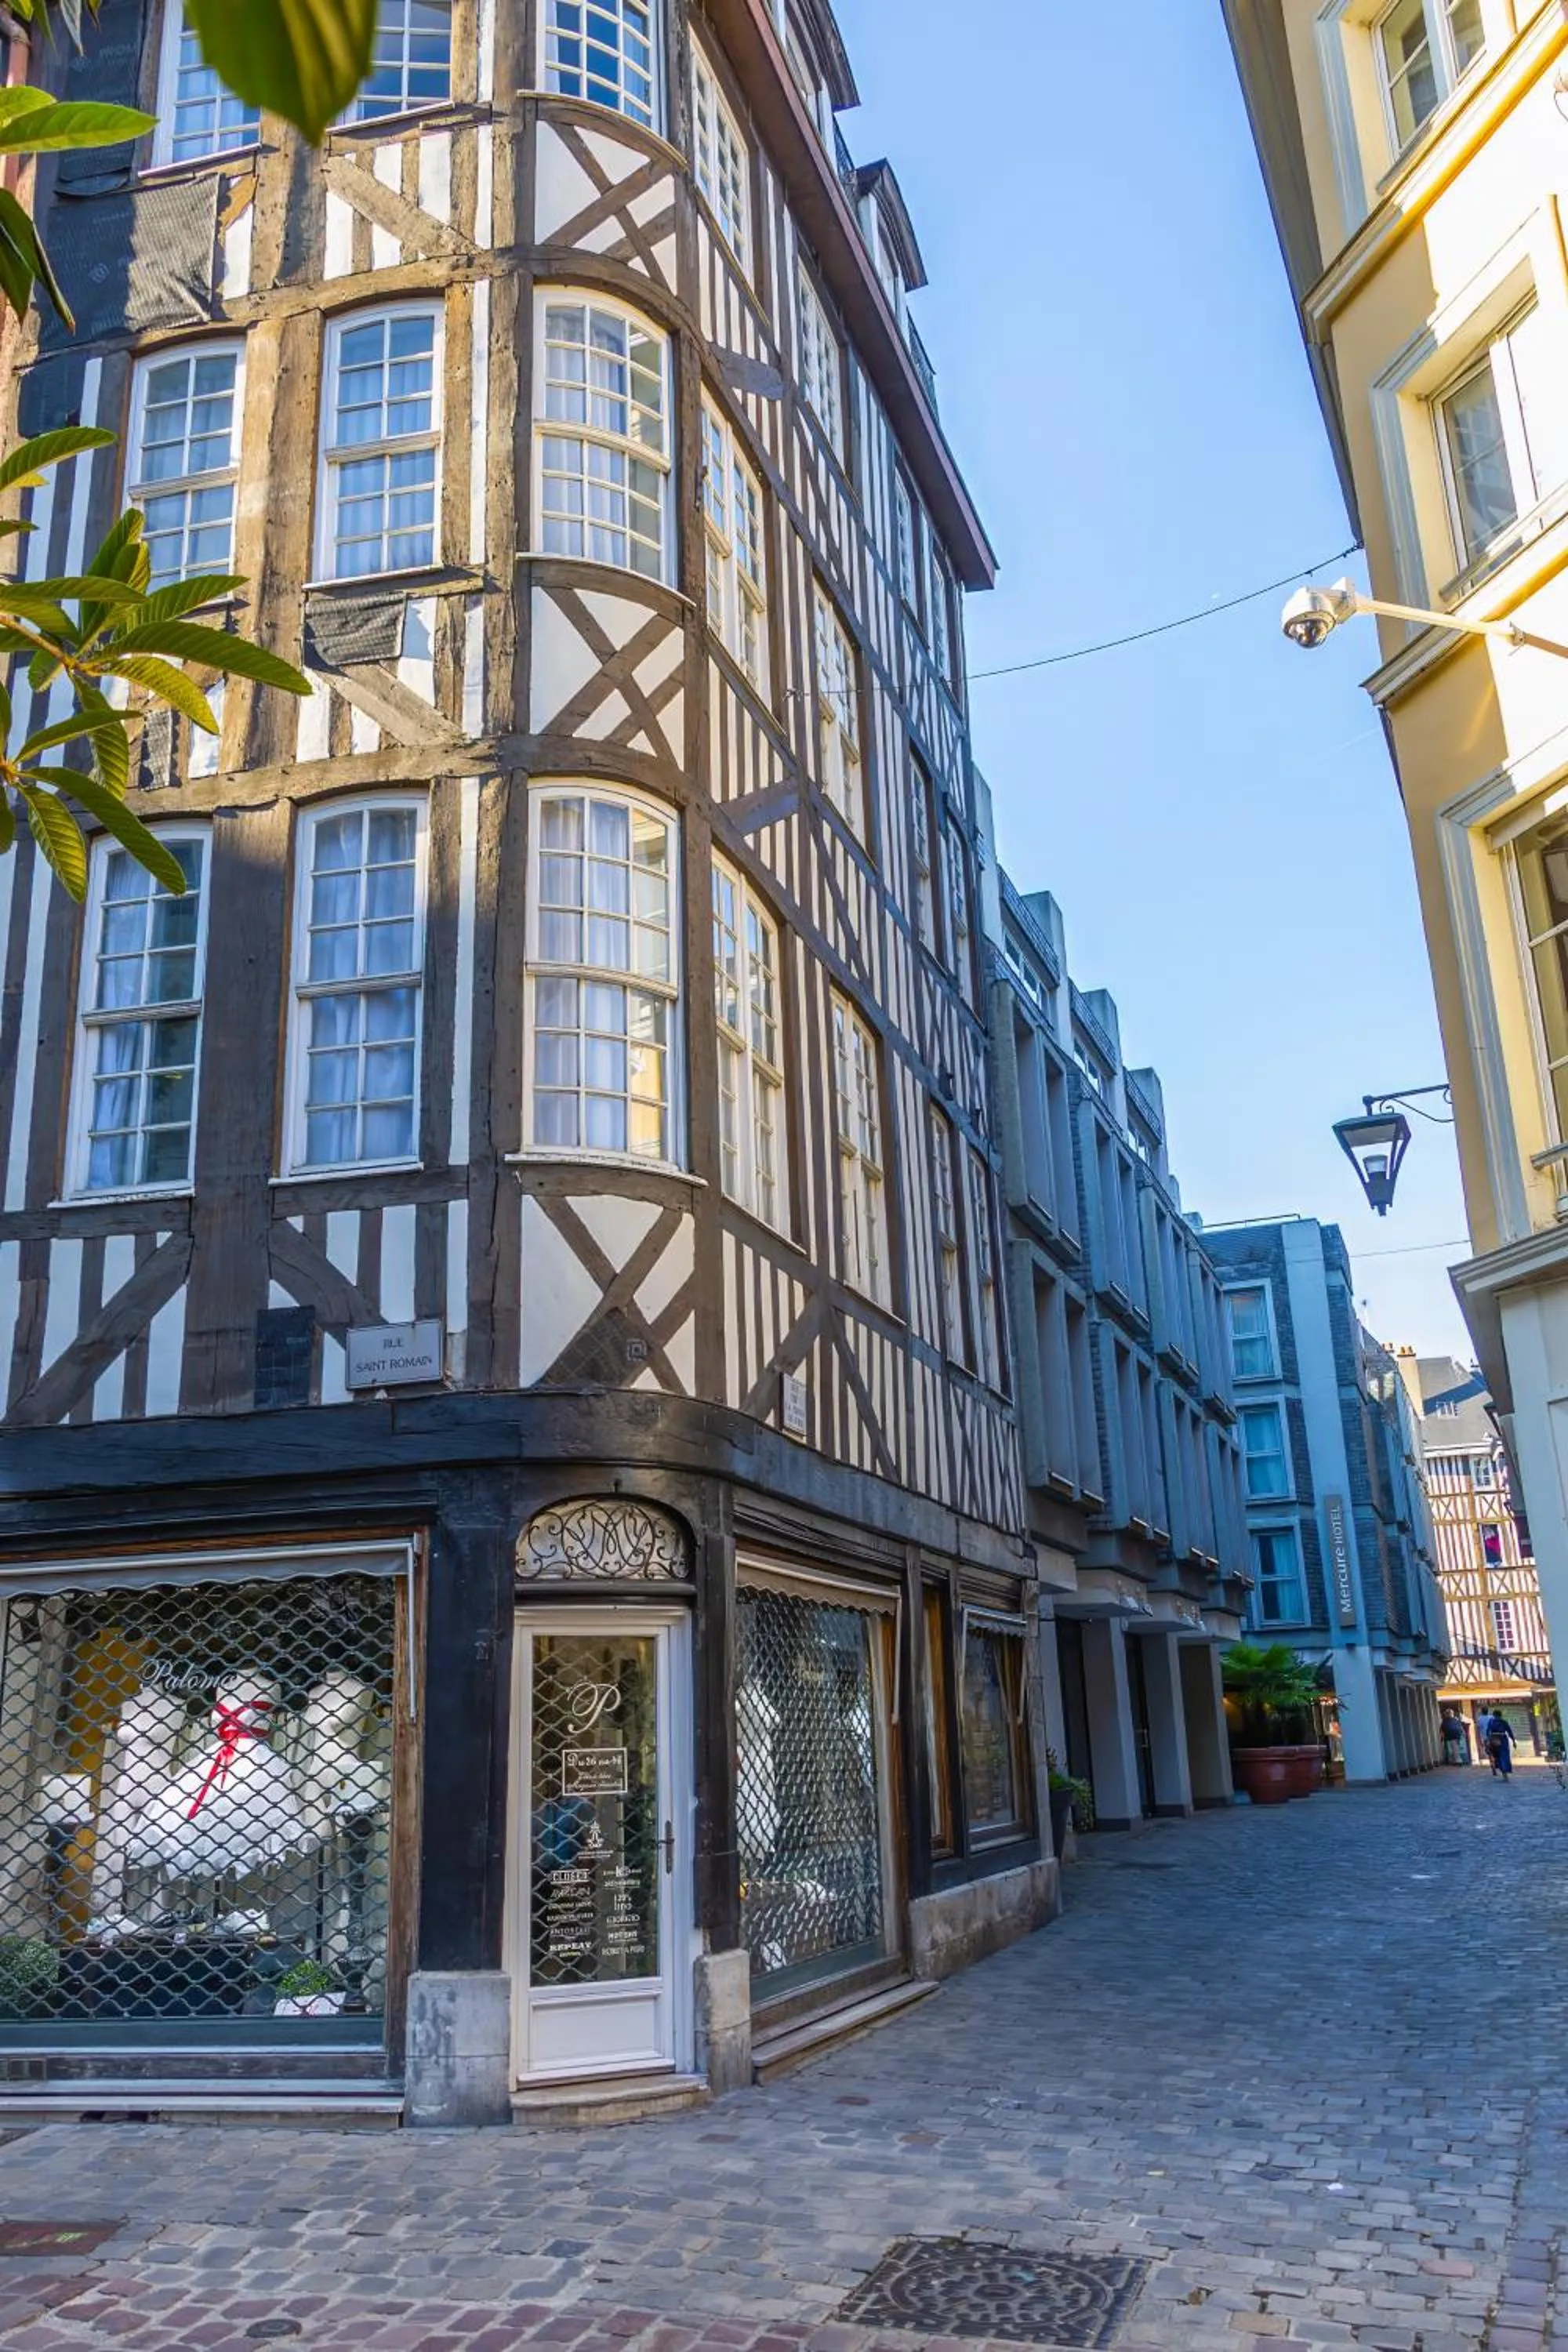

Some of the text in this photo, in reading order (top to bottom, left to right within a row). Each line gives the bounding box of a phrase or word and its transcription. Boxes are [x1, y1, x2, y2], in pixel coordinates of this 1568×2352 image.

[355, 1355, 433, 1373] SAINT ROMAIN
[1330, 1504, 1353, 1613] Mercure HOTEL
[567, 1682, 622, 1734] P
